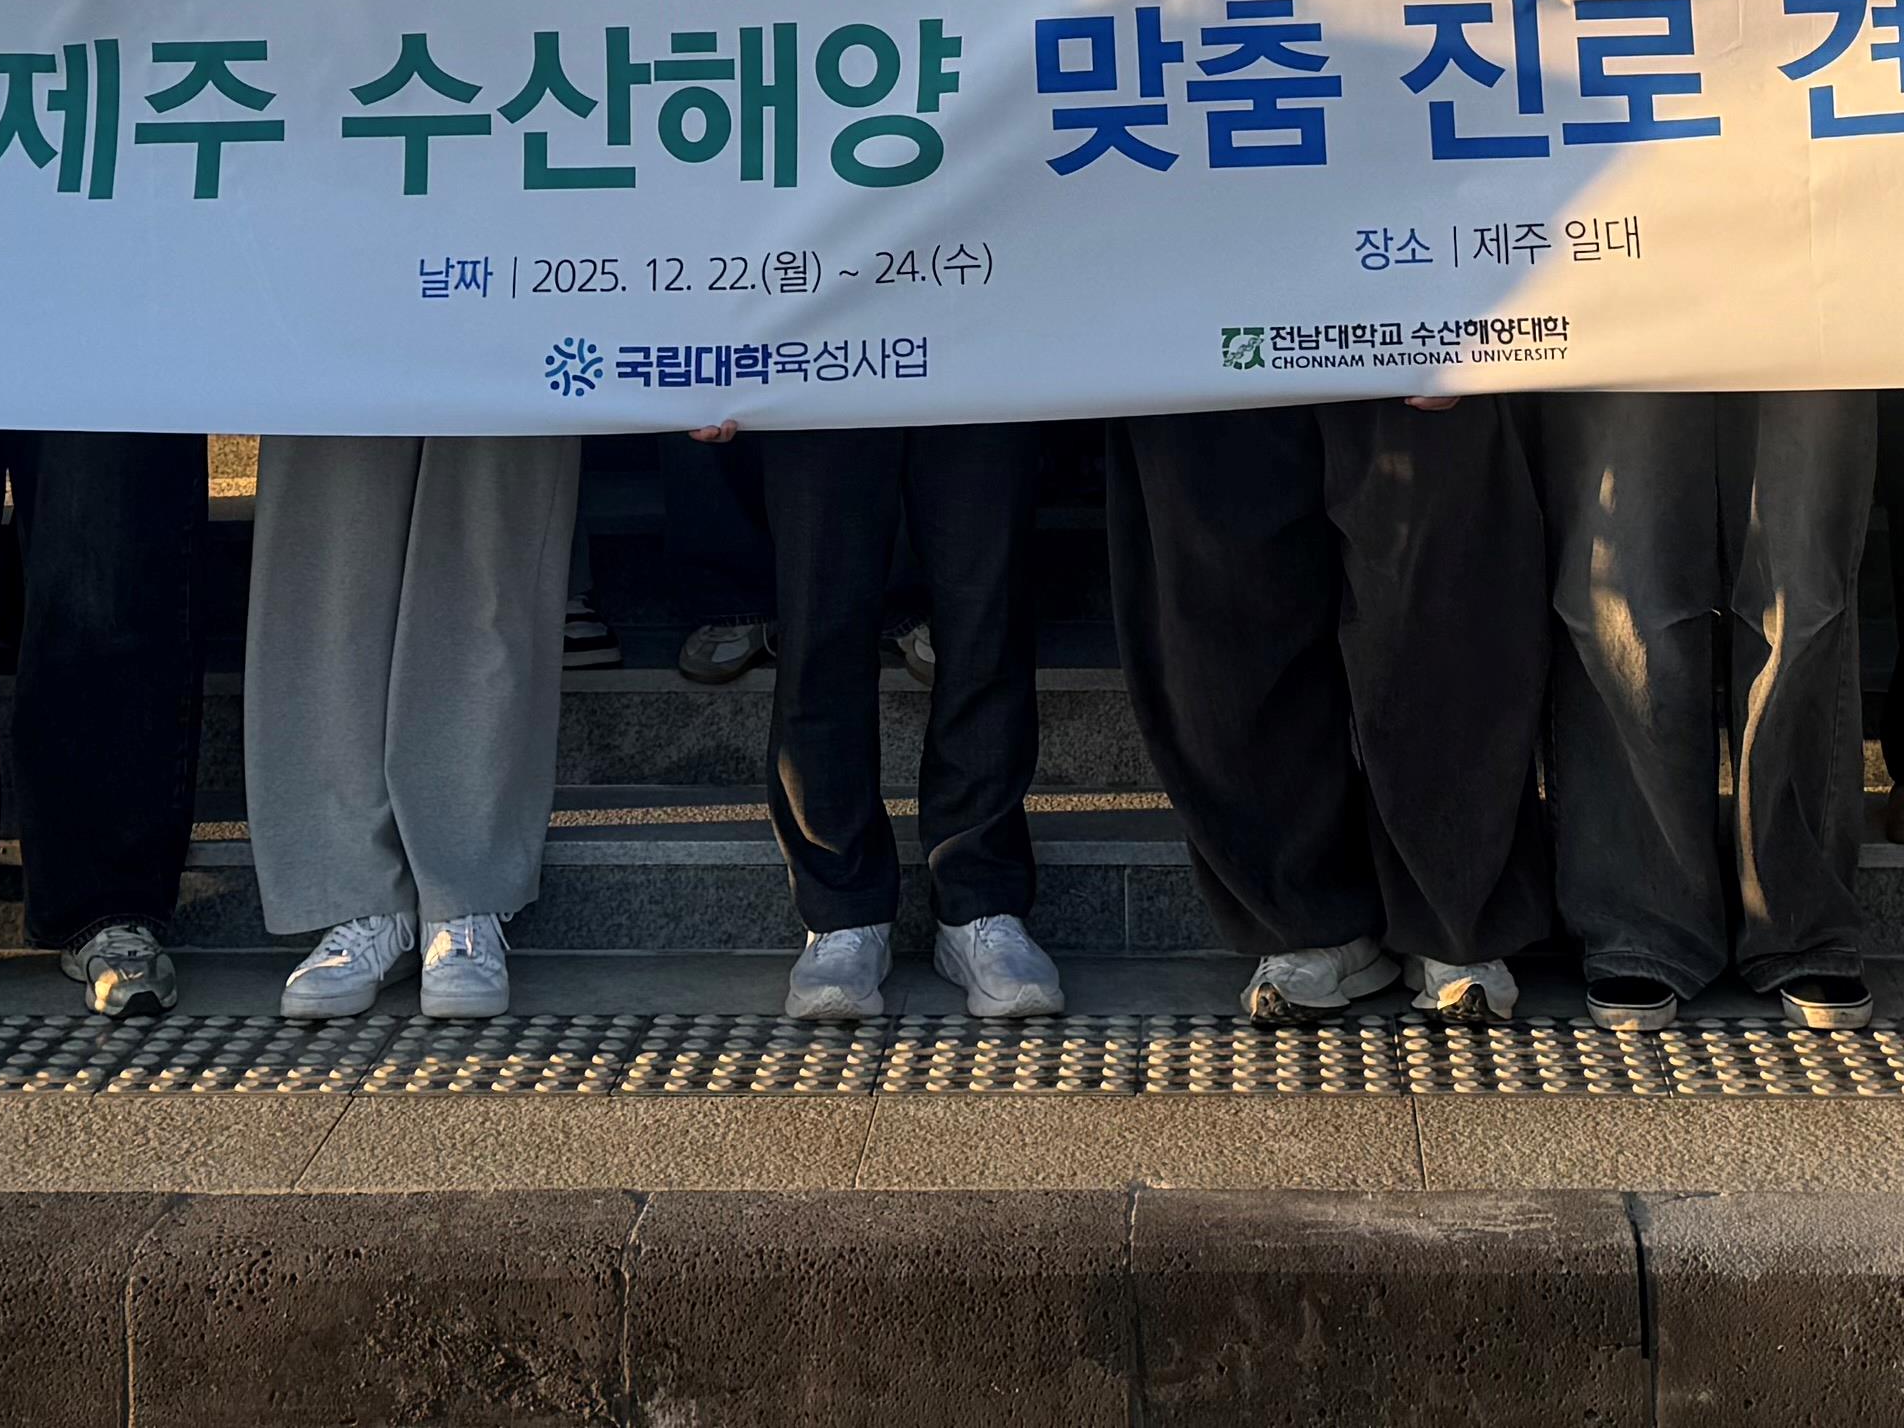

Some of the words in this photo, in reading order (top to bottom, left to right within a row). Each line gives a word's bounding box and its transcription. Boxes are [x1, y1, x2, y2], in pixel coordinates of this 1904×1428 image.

[340, 17, 964, 198] 수산해양
[1354, 227, 1434, 271] 장소
[1471, 221, 1553, 266] 제주
[1564, 214, 1642, 261] 일대
[417, 255, 494, 299] 날짜
[531, 258, 628, 294] 2025.
[645, 257, 693, 292] 12.
[708, 249, 823, 295] 22.(월)
[873, 241, 994, 286] 24.(수)
[1269, 321, 1403, 352] 전남대학교
[1409, 315, 1570, 346] 수산해양대학
[1271, 354, 1365, 370] CHONNAM
[1372, 350, 1464, 366] NATIONAL
[1471, 345, 1569, 363] UNIVERSITY
[614, 336, 930, 387] 국립대학육성사업
